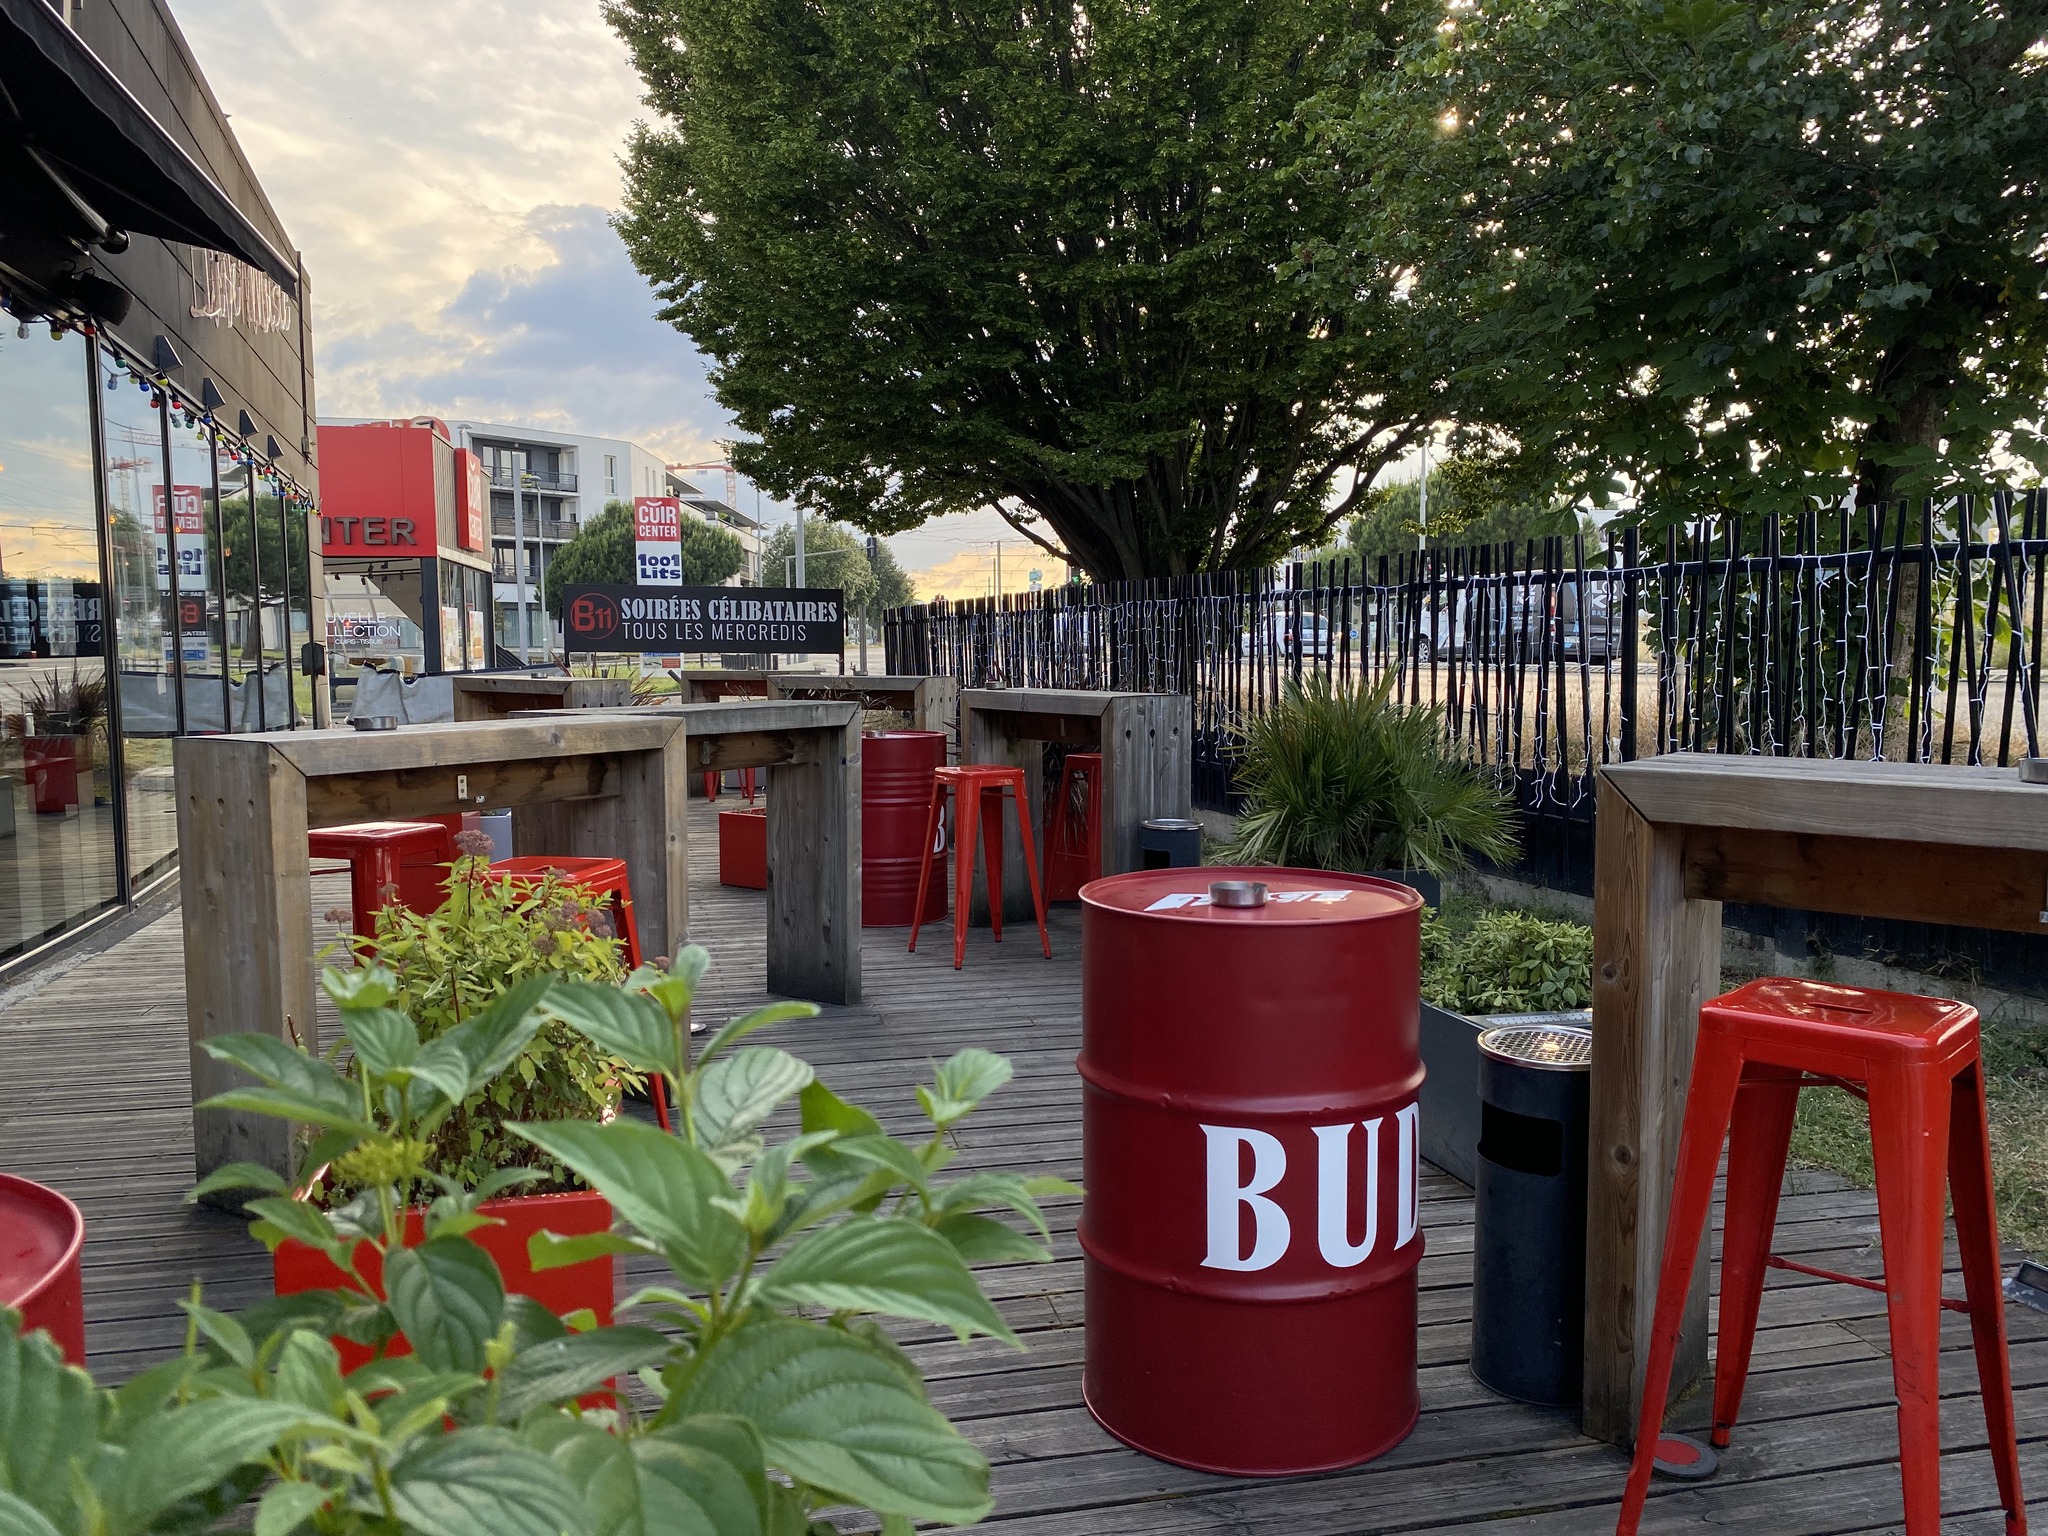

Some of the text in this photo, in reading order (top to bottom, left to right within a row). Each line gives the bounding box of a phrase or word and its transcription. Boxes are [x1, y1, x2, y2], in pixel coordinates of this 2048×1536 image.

[640, 525, 677, 537] CENTER
[641, 567, 681, 579] Lits
[574, 600, 612, 631] B11
[621, 594, 838, 622] SOIRÉES CÉLIBATAIRES
[622, 622, 807, 641] TOUS LES MERCREDIS
[1199, 1102, 1420, 1272] BUD
